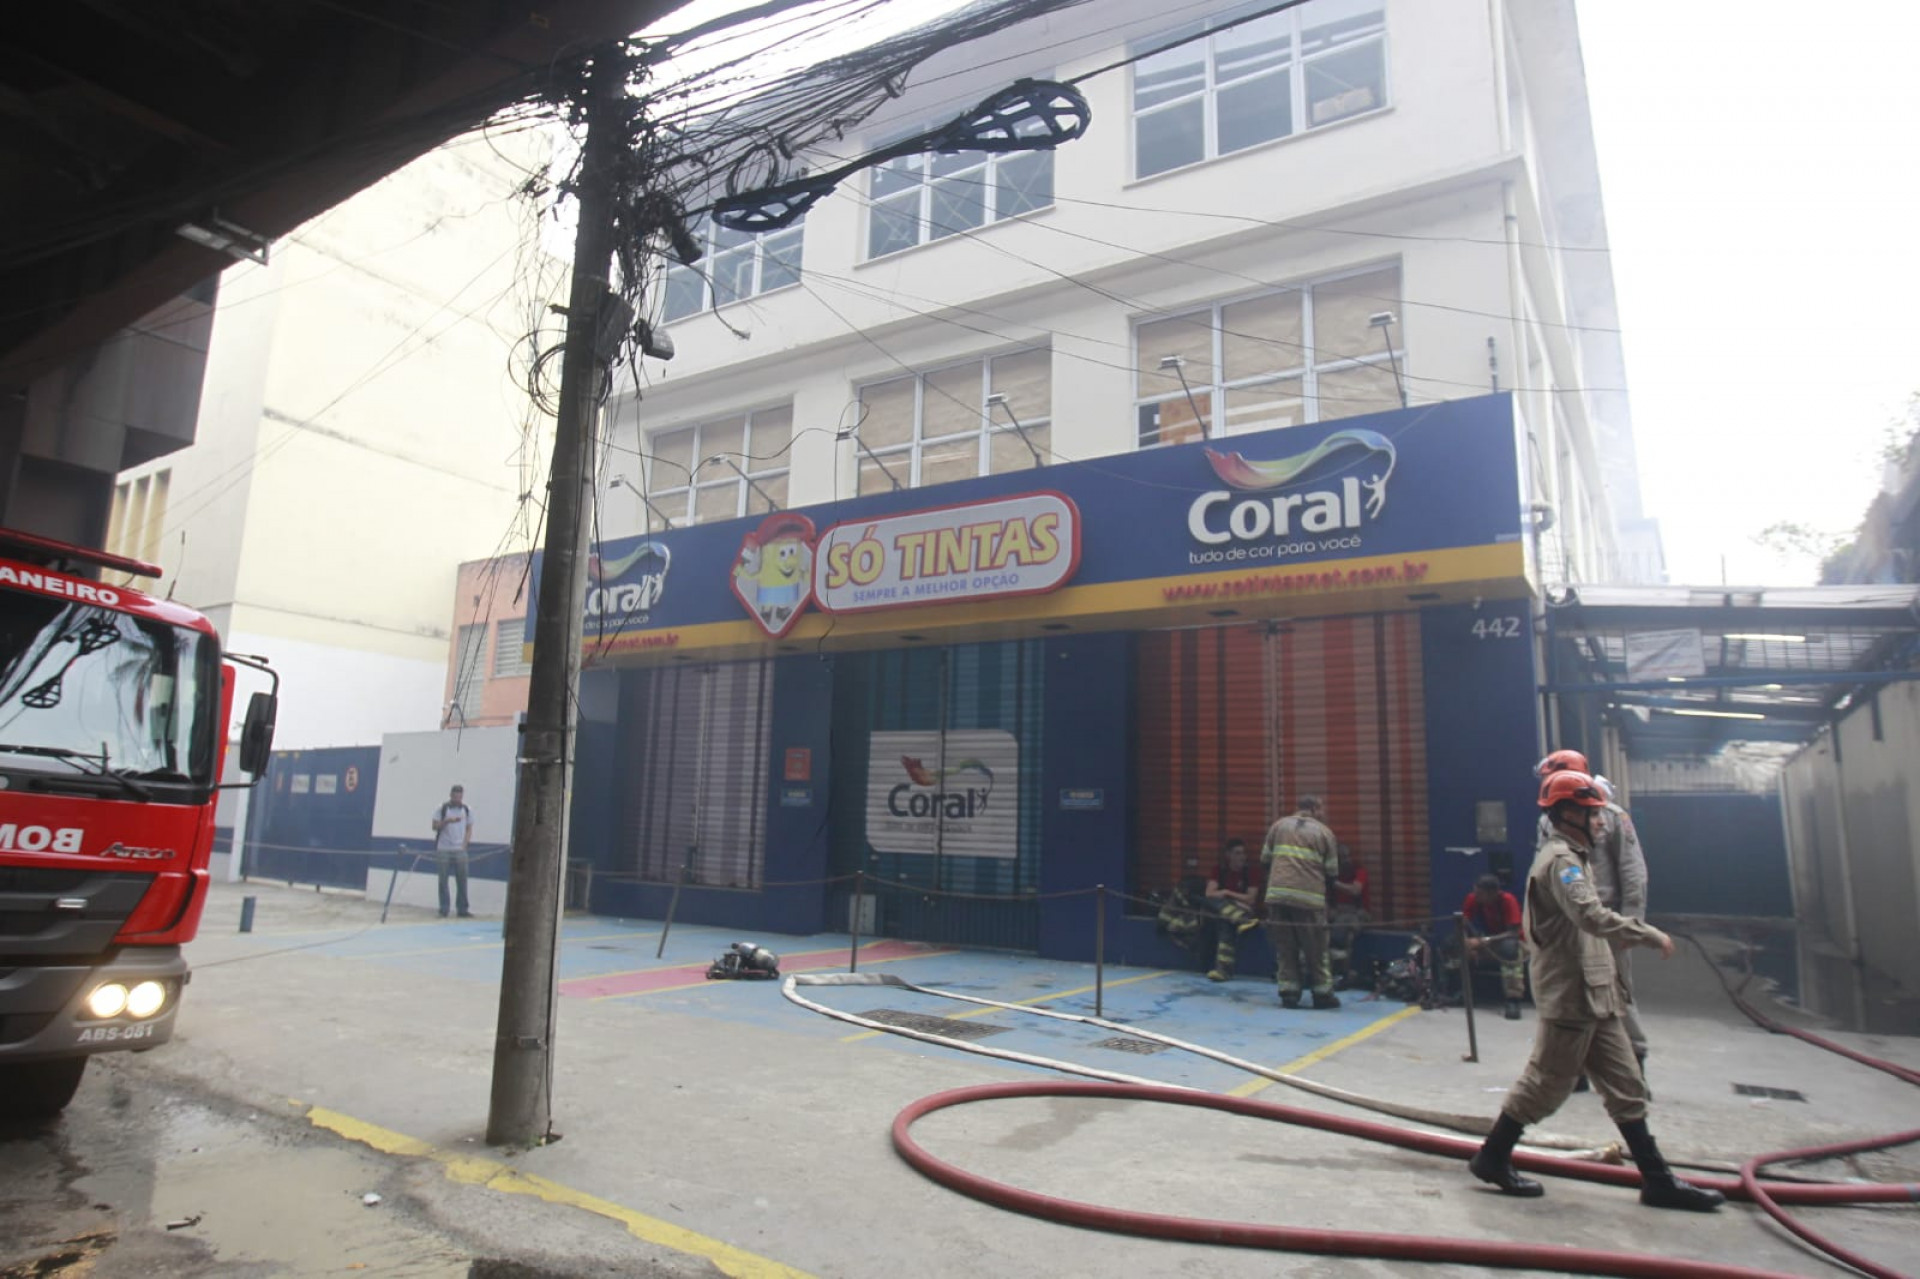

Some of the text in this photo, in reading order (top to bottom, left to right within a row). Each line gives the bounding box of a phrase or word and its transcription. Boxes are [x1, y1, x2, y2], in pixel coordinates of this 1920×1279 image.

[1188, 476, 1361, 544] Coral
[827, 512, 1059, 589] SÓ TINTAS
[1189, 534, 1362, 564] tudo de cor para você
[584, 575, 651, 616] oral
[854, 587, 897, 602] SEMPRE
[901, 586, 911, 597] A
[915, 578, 967, 595] MELHOR
[1472, 617, 1520, 639] 442
[888, 784, 975, 818] Coral
